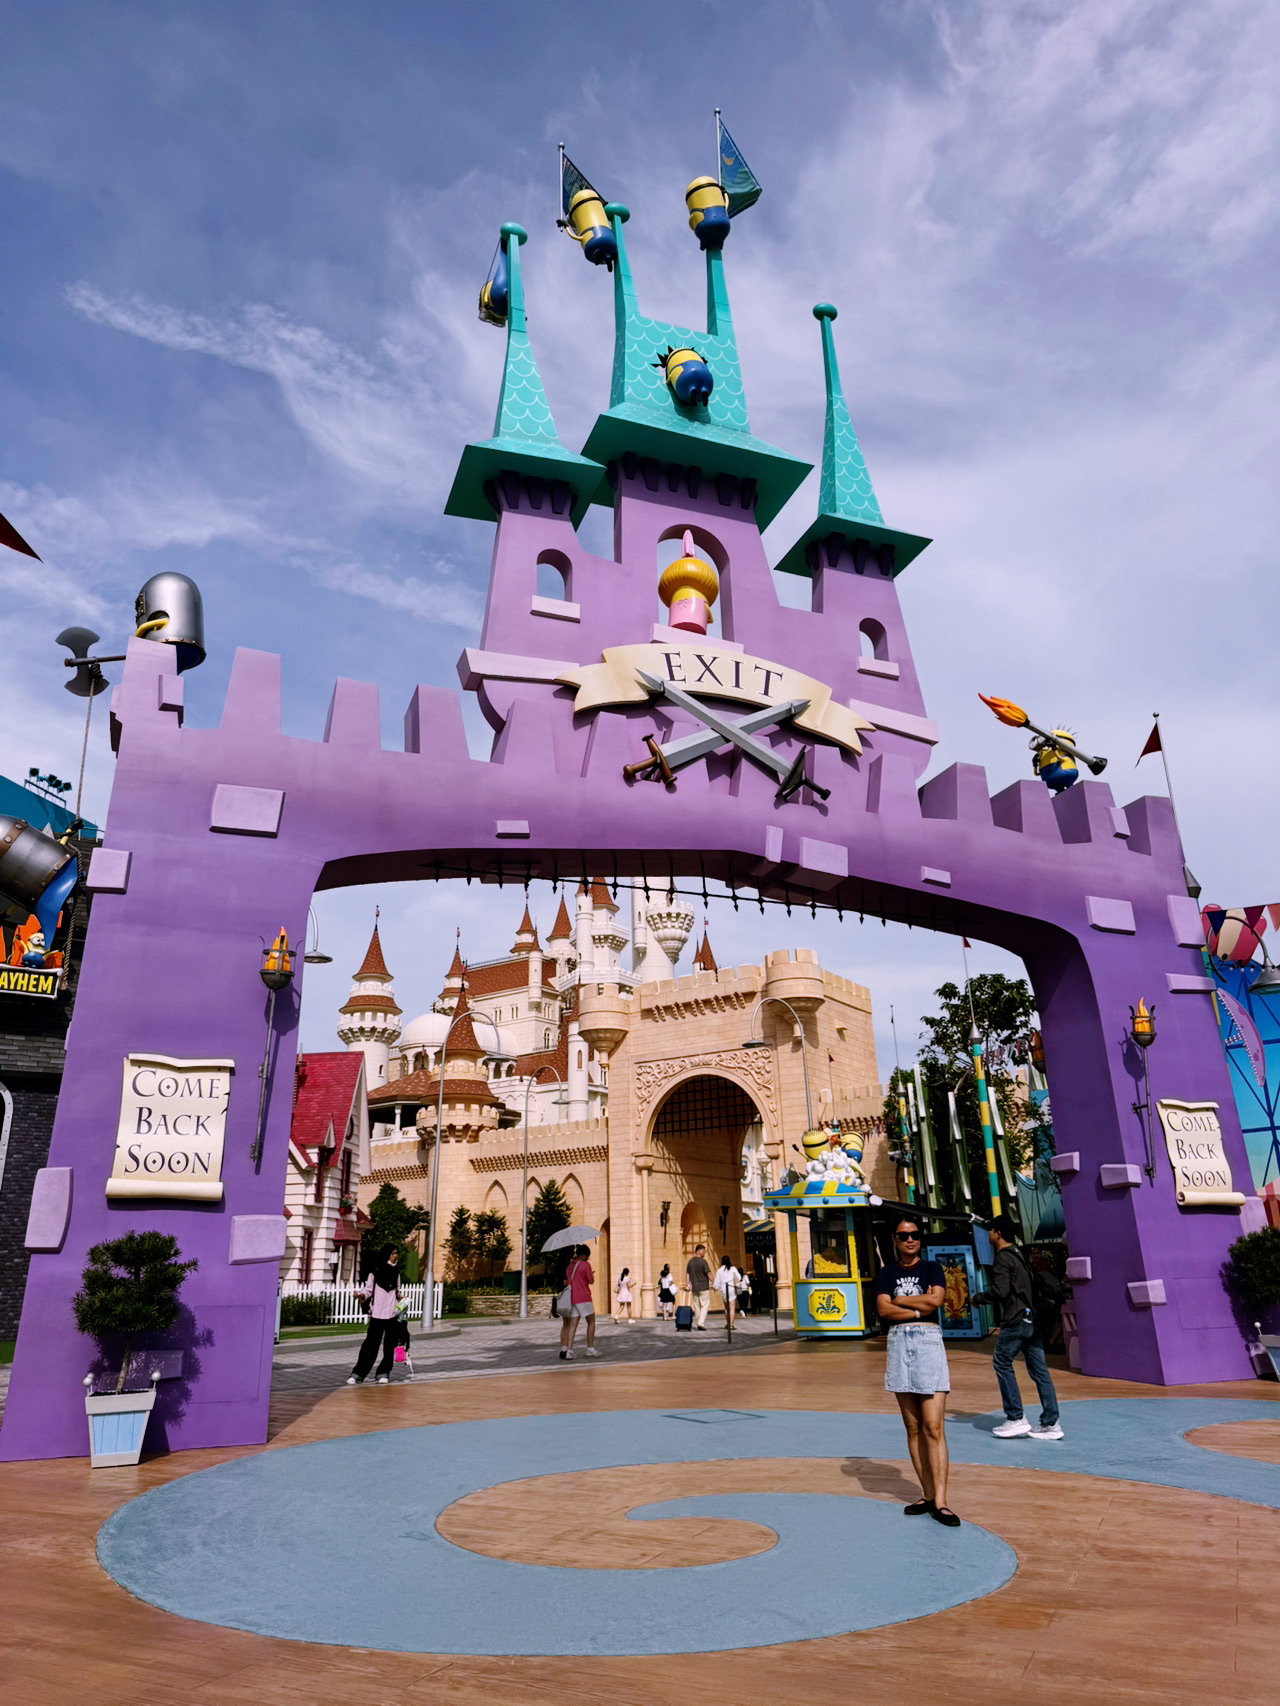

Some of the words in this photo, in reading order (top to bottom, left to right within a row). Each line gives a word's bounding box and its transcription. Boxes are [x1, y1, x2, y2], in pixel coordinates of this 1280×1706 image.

[660, 651, 783, 698] EXIT
[0, 971, 53, 994] AYHEM
[132, 1069, 221, 1099] COME
[133, 1106, 212, 1136] BACK
[1166, 1112, 1216, 1132] COME
[124, 1144, 212, 1176] SOON
[1175, 1139, 1219, 1159] BACK
[1181, 1166, 1227, 1188] SOON
